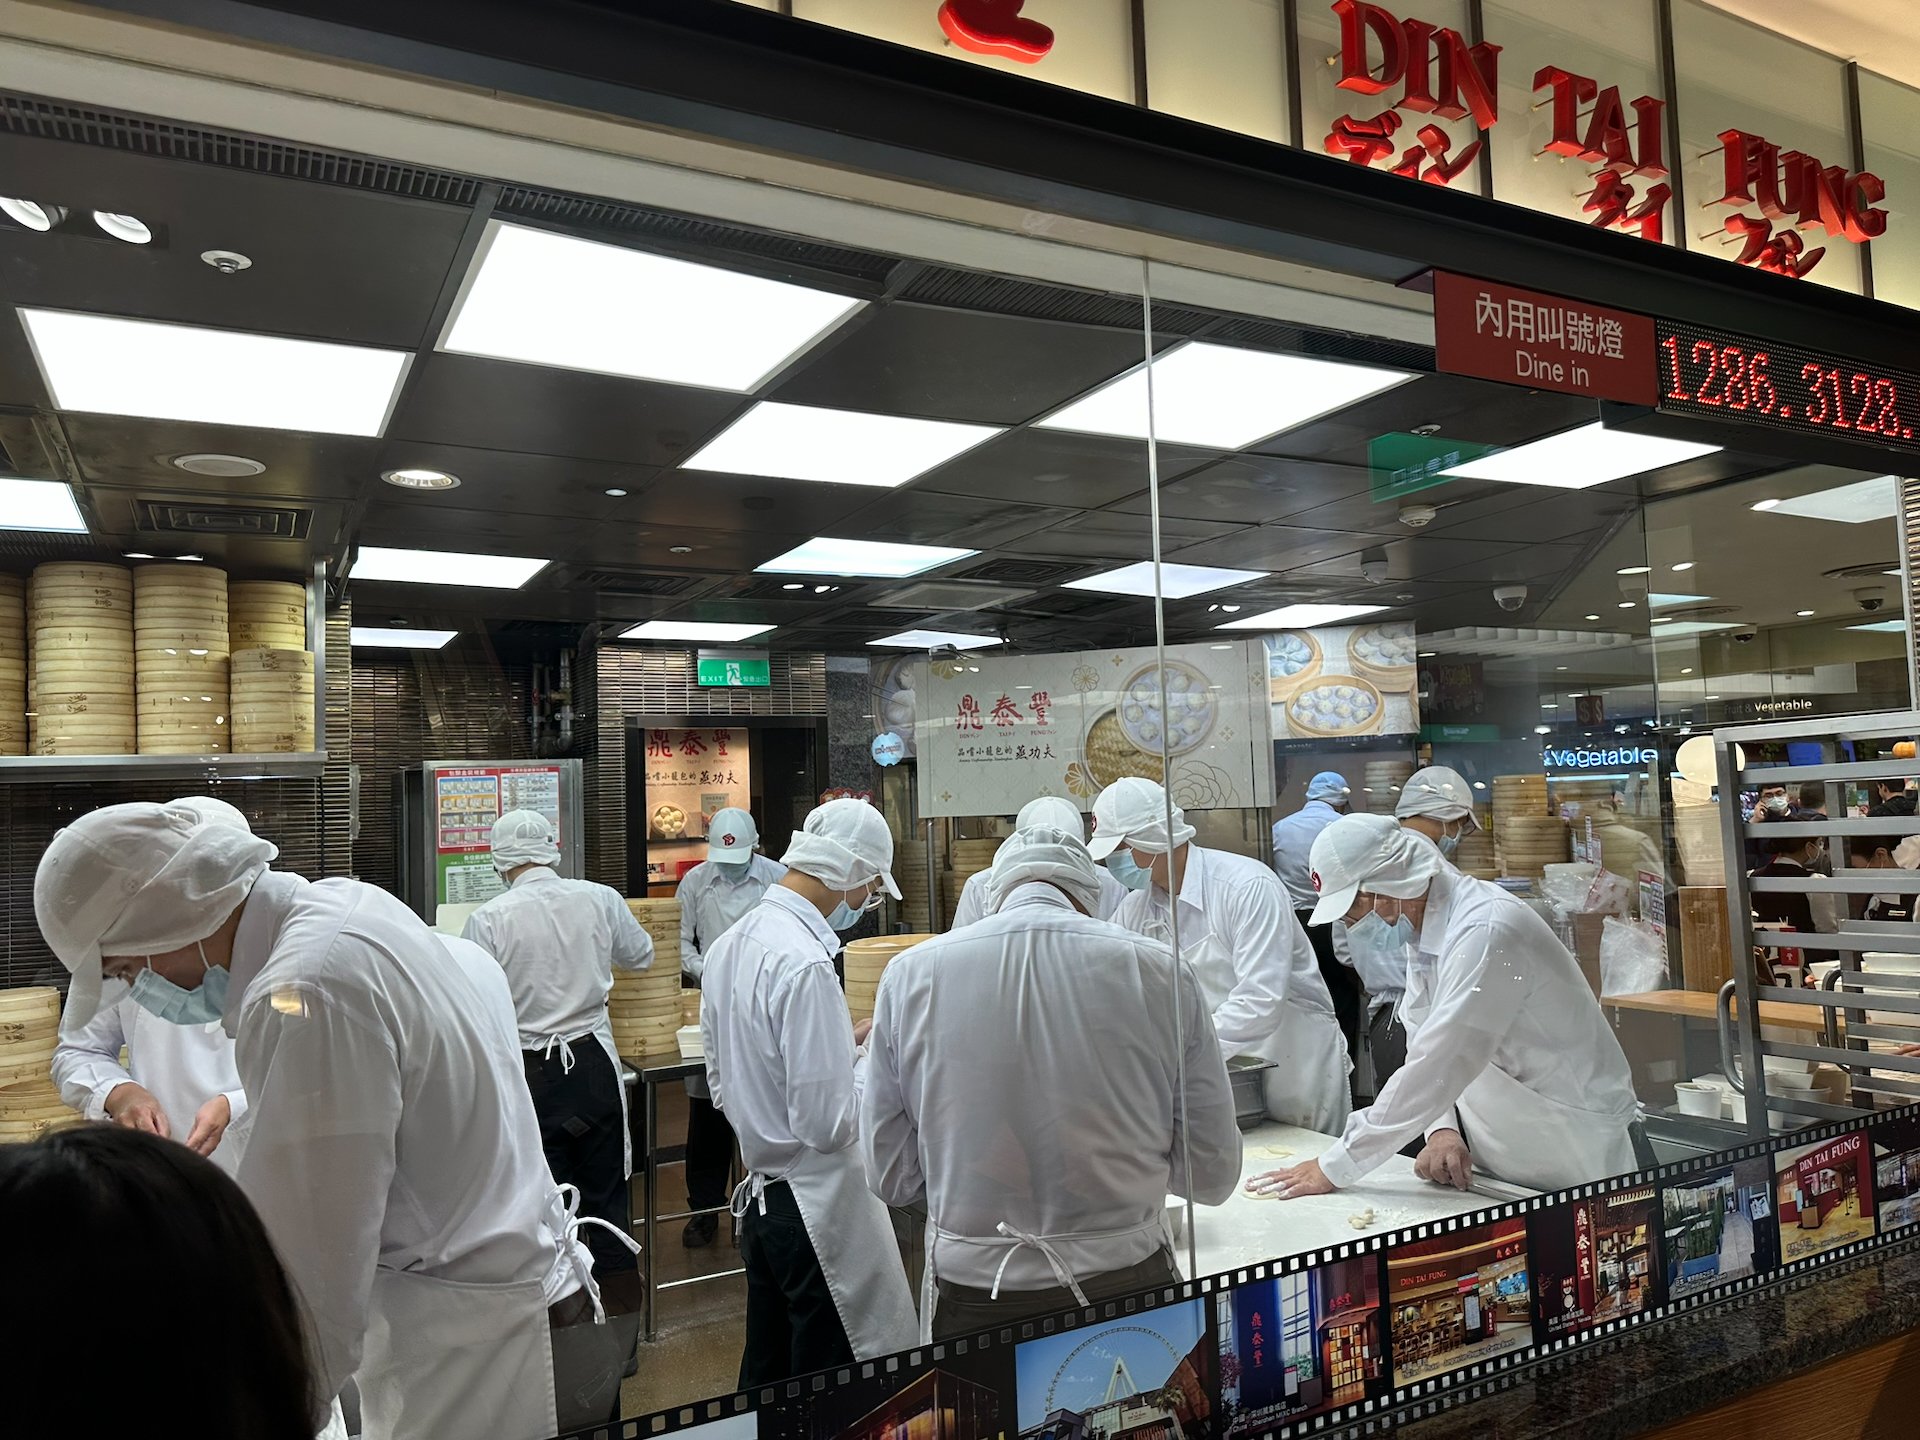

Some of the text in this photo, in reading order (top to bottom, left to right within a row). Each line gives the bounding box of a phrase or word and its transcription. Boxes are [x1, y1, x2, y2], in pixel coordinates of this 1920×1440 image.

[1331, 0, 1889, 243] DIN TAI FUNG
[1516, 350, 1590, 388] Dine in
[700, 675, 724, 683] EXIT
[955, 691, 1051, 730] 鼎泰豐
[1754, 699, 1813, 713] Vegetable
[1551, 747, 1658, 768] Vegetable
[1799, 1136, 1860, 1172] DIN TAI FUNG
